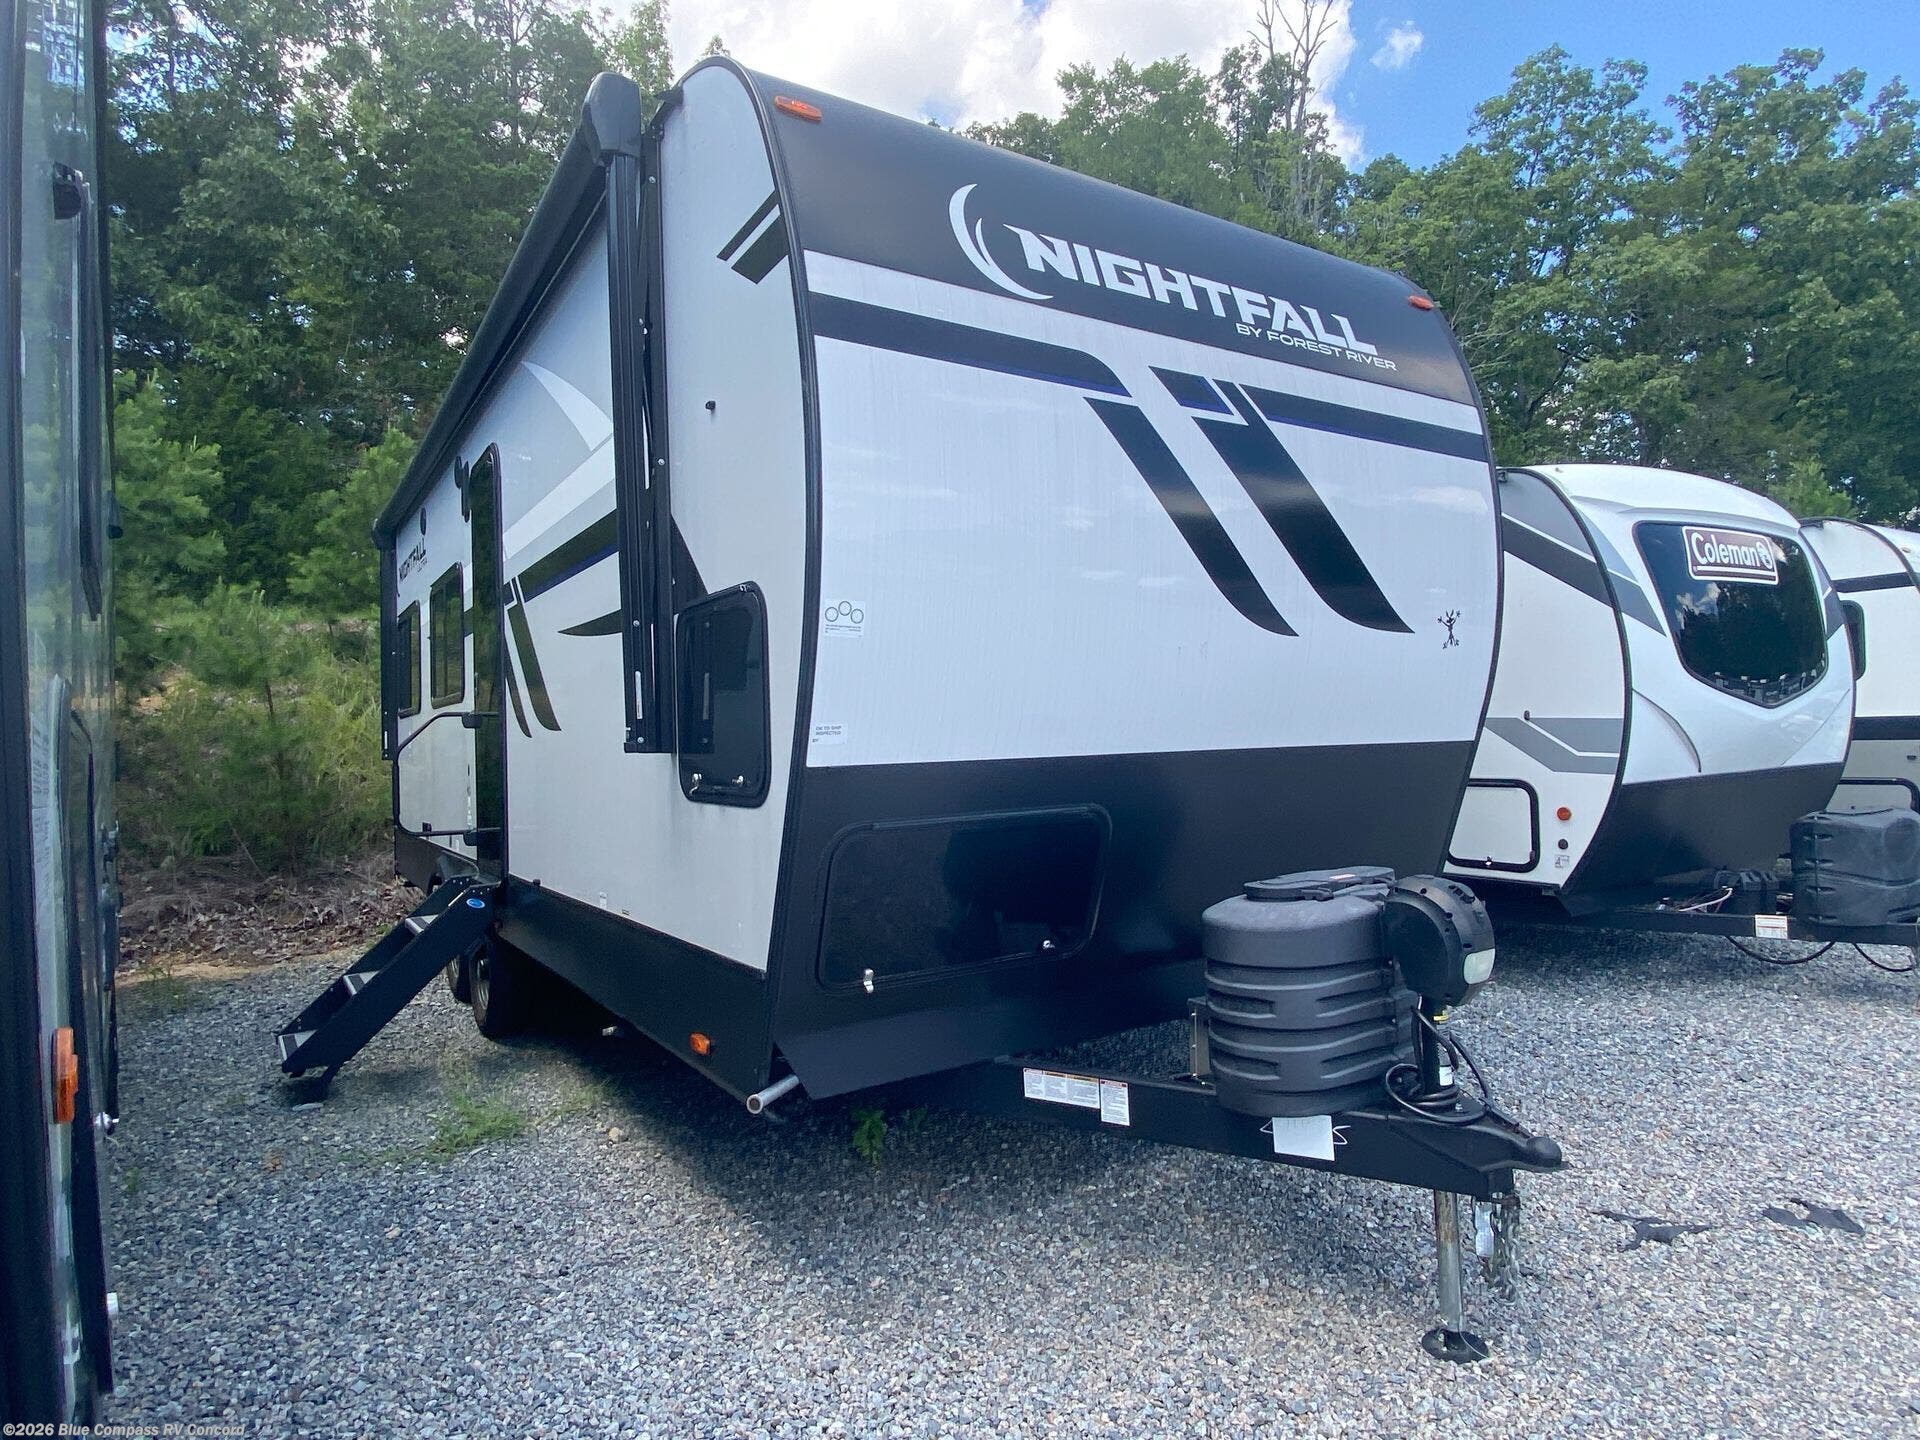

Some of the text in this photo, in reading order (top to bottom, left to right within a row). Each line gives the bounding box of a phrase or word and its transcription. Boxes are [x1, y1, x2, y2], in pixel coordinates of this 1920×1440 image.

[1003, 223, 1378, 356] NIGHTFALL
[1236, 323, 1397, 371] BY FOREST RIVER
[1691, 532, 1761, 567] Coleman
